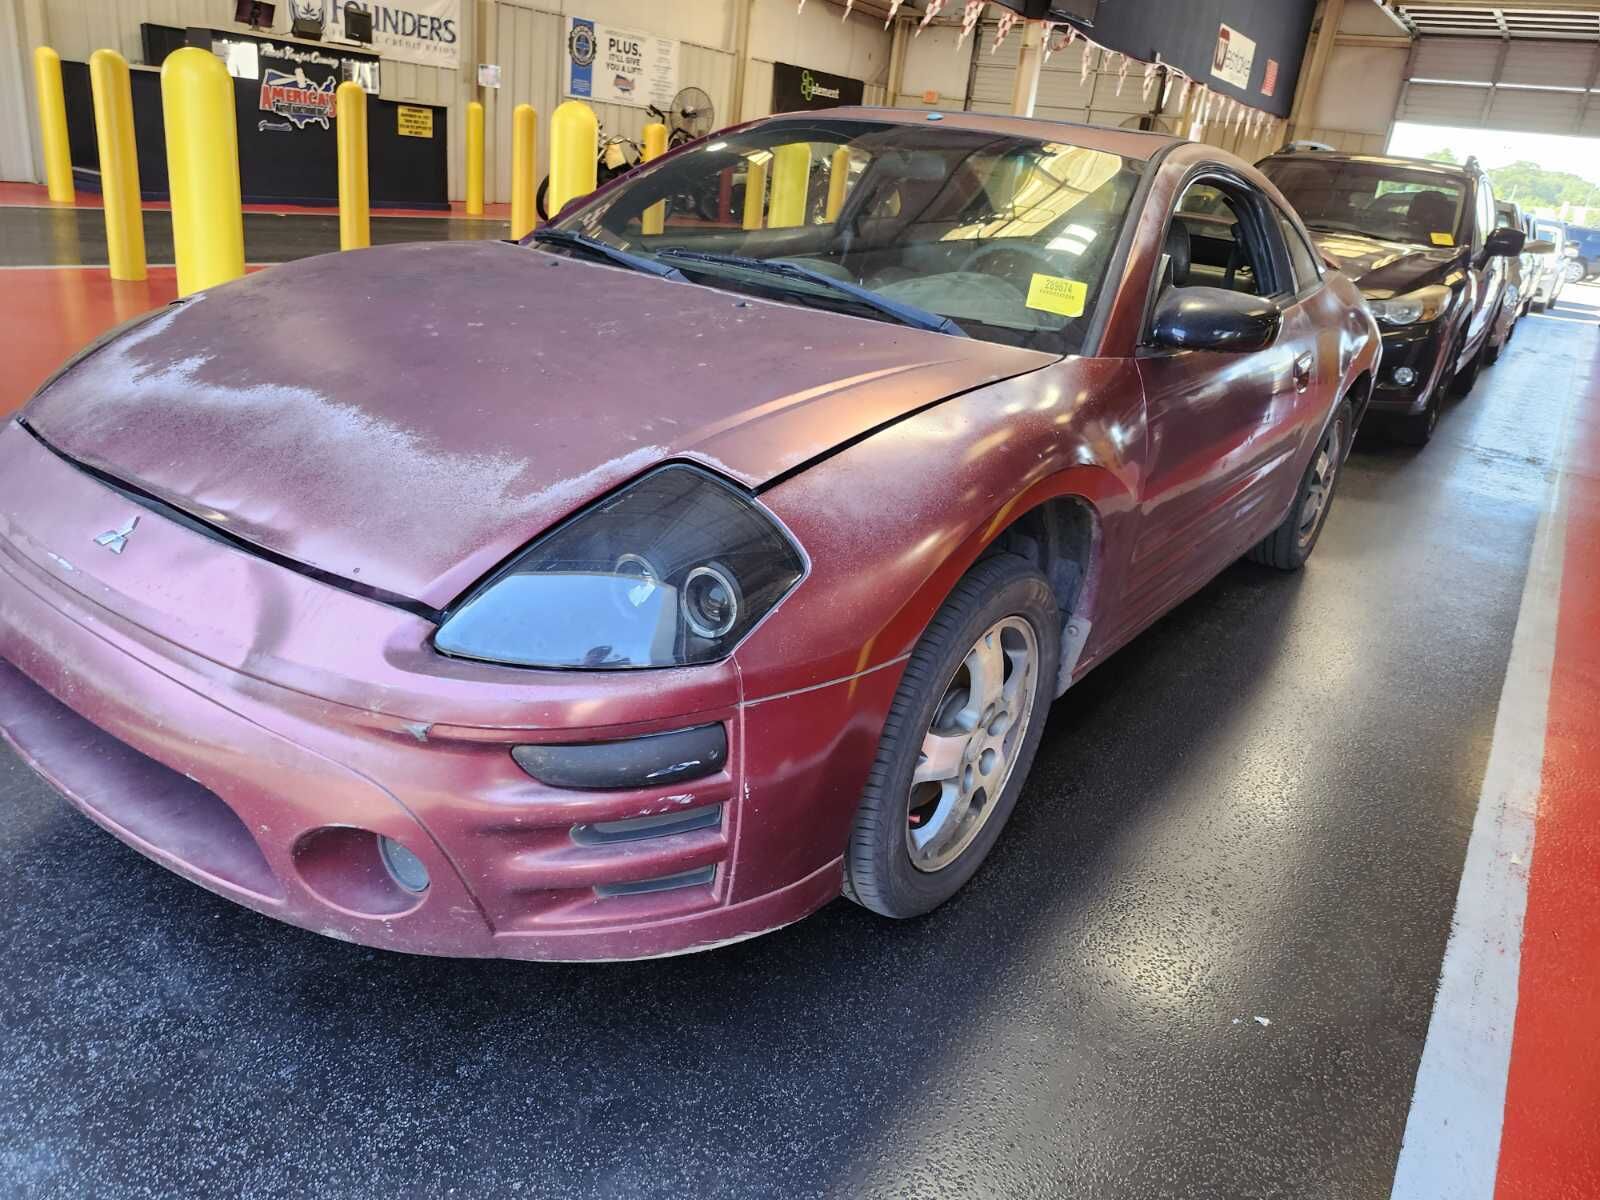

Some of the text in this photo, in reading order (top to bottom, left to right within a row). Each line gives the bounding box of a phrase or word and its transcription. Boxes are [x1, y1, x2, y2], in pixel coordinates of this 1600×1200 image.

[608, 38, 642, 57] PLUS.
[812, 83, 840, 99] element
[259, 84, 337, 118] AMERICA'S
